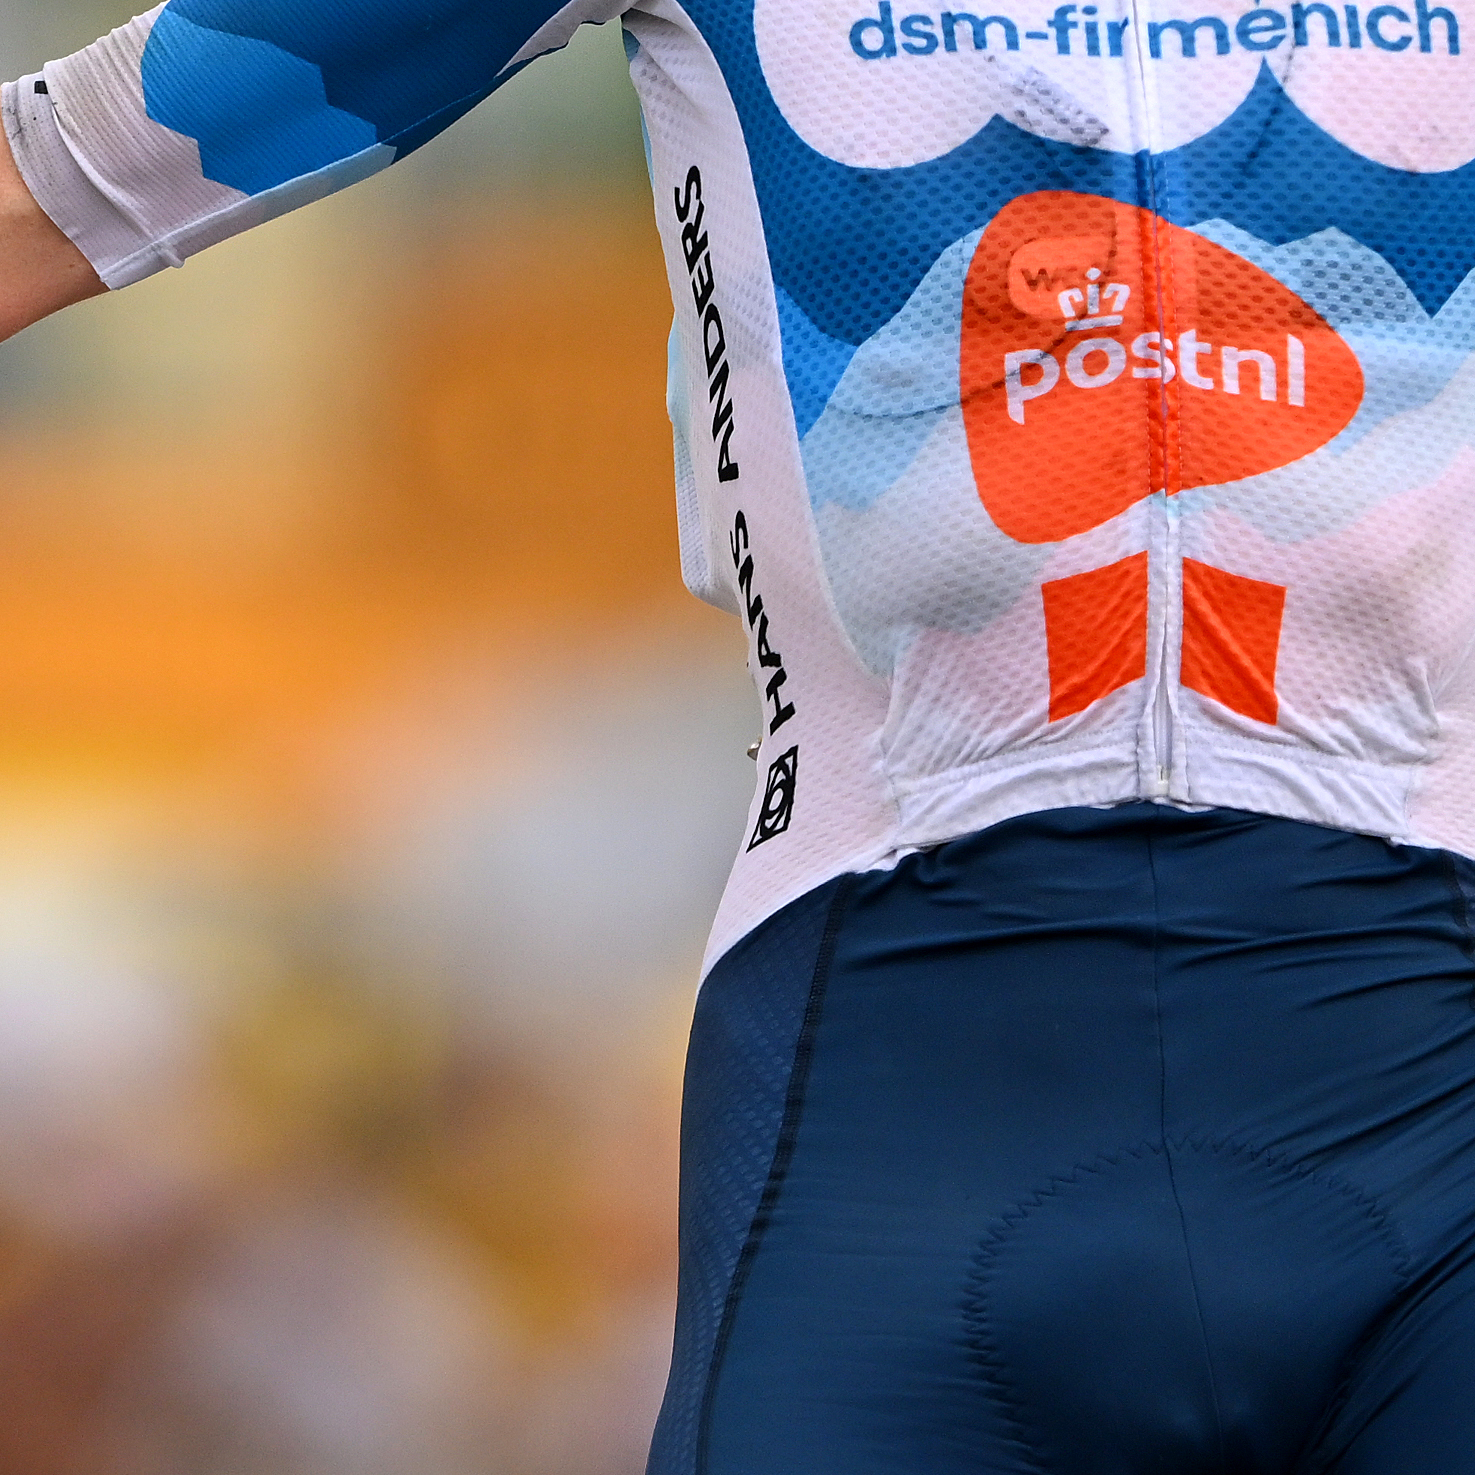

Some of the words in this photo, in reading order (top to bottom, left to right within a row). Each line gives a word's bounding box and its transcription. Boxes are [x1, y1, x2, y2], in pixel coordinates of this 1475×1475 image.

[674, 164, 738, 483] ANDERS
[1004, 328, 1305, 425] postnl
[729, 509, 796, 736] HANS
